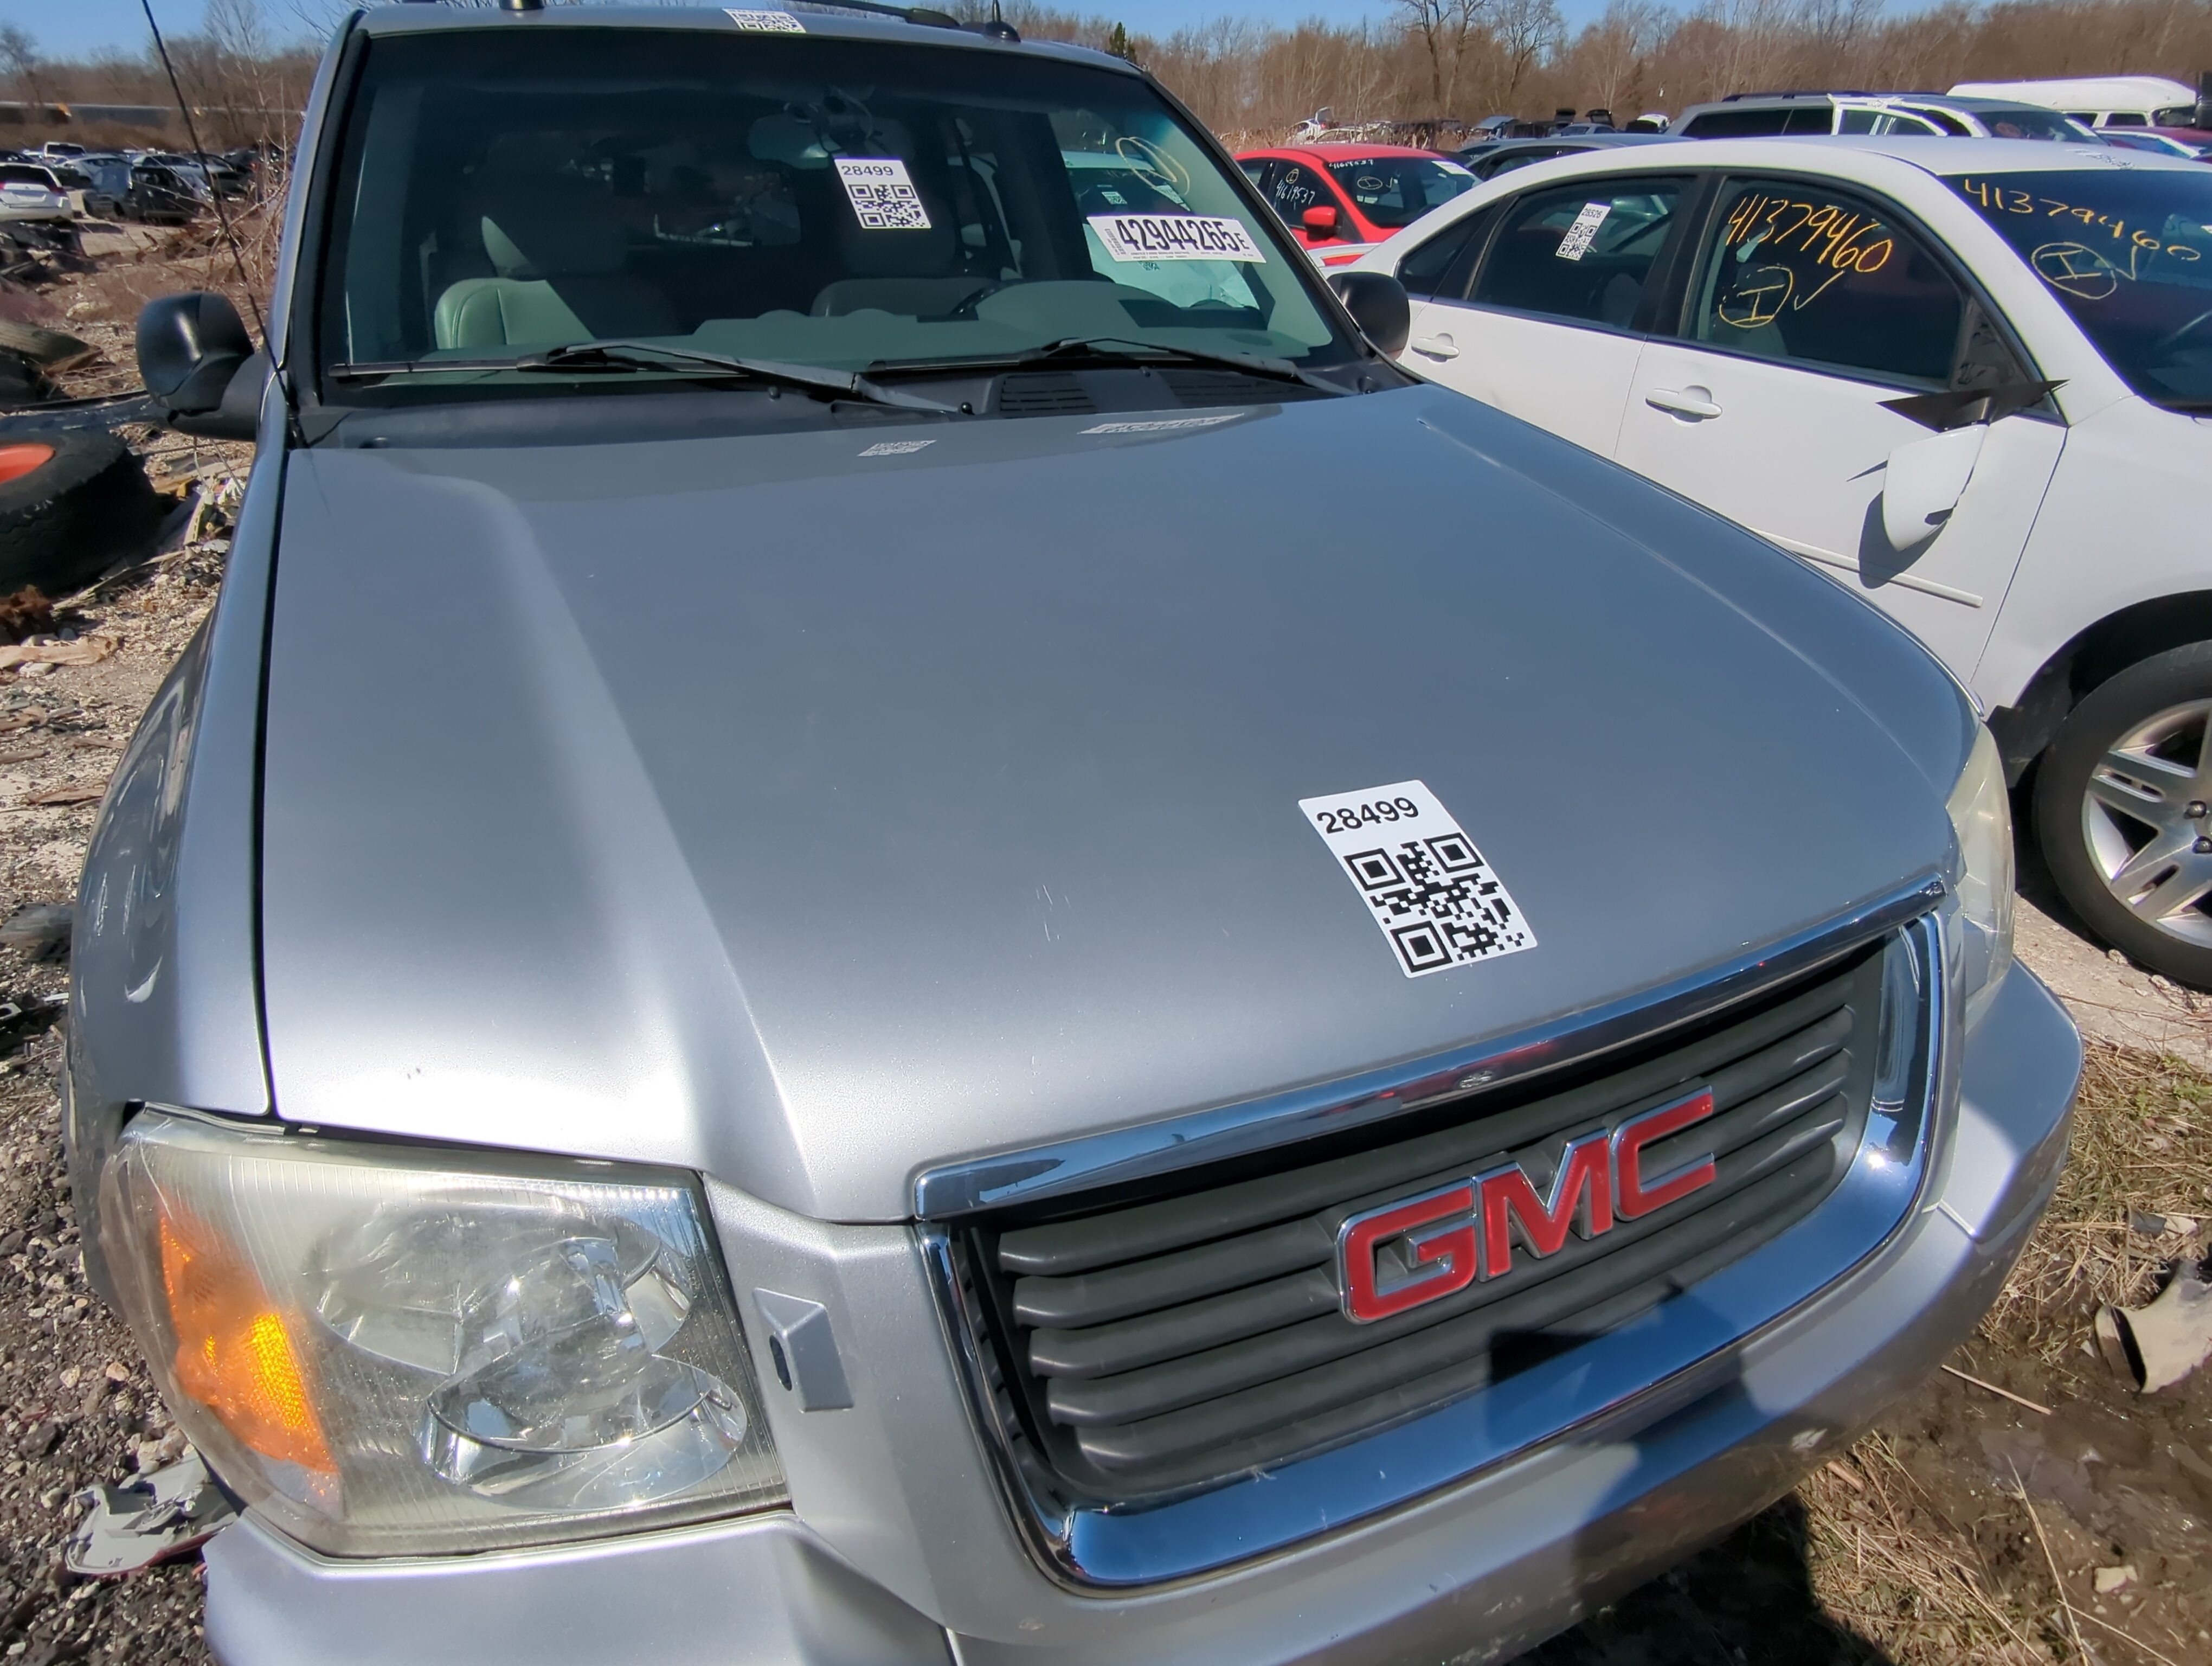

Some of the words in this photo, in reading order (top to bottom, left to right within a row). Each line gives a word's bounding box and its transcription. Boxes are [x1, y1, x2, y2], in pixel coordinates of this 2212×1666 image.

[841, 165, 894, 176] 28499
[1276, 180, 1316, 206] 41619537
[1115, 219, 1240, 252] 42944265
[1726, 194, 1893, 273] 41379460
[1964, 178, 2201, 261] 41379460
[1316, 797, 1419, 834] 28499
[1335, 1085, 1717, 1325] GMC
